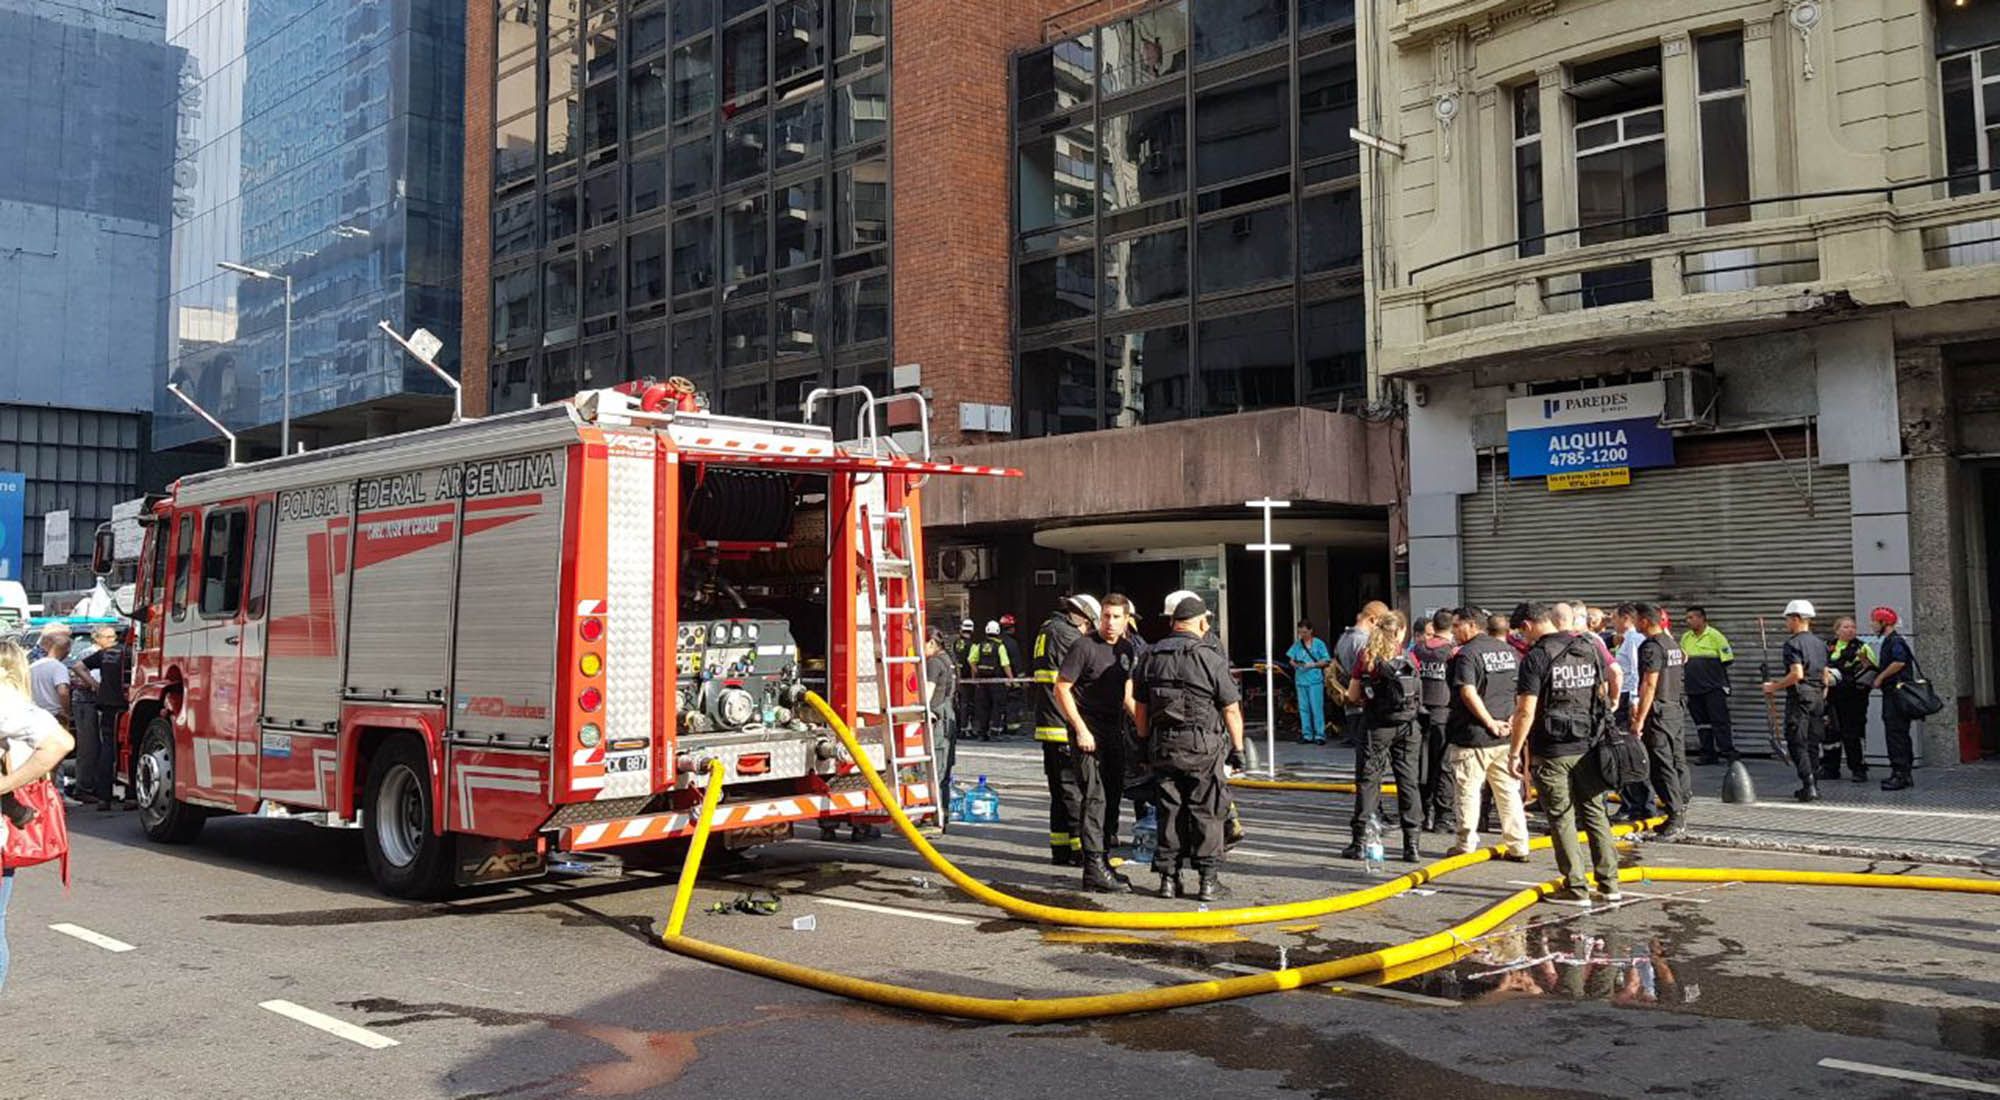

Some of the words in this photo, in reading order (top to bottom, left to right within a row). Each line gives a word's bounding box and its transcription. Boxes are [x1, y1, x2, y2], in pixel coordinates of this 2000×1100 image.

[1565, 393, 1628, 410] PAREDES
[1548, 429, 1628, 451] ALQUILA
[1550, 447, 1628, 467] 4785-1200
[280, 485, 340, 521] POLICIA
[347, 471, 426, 513] FEDERAL
[435, 453, 557, 500] ARGENTINA
